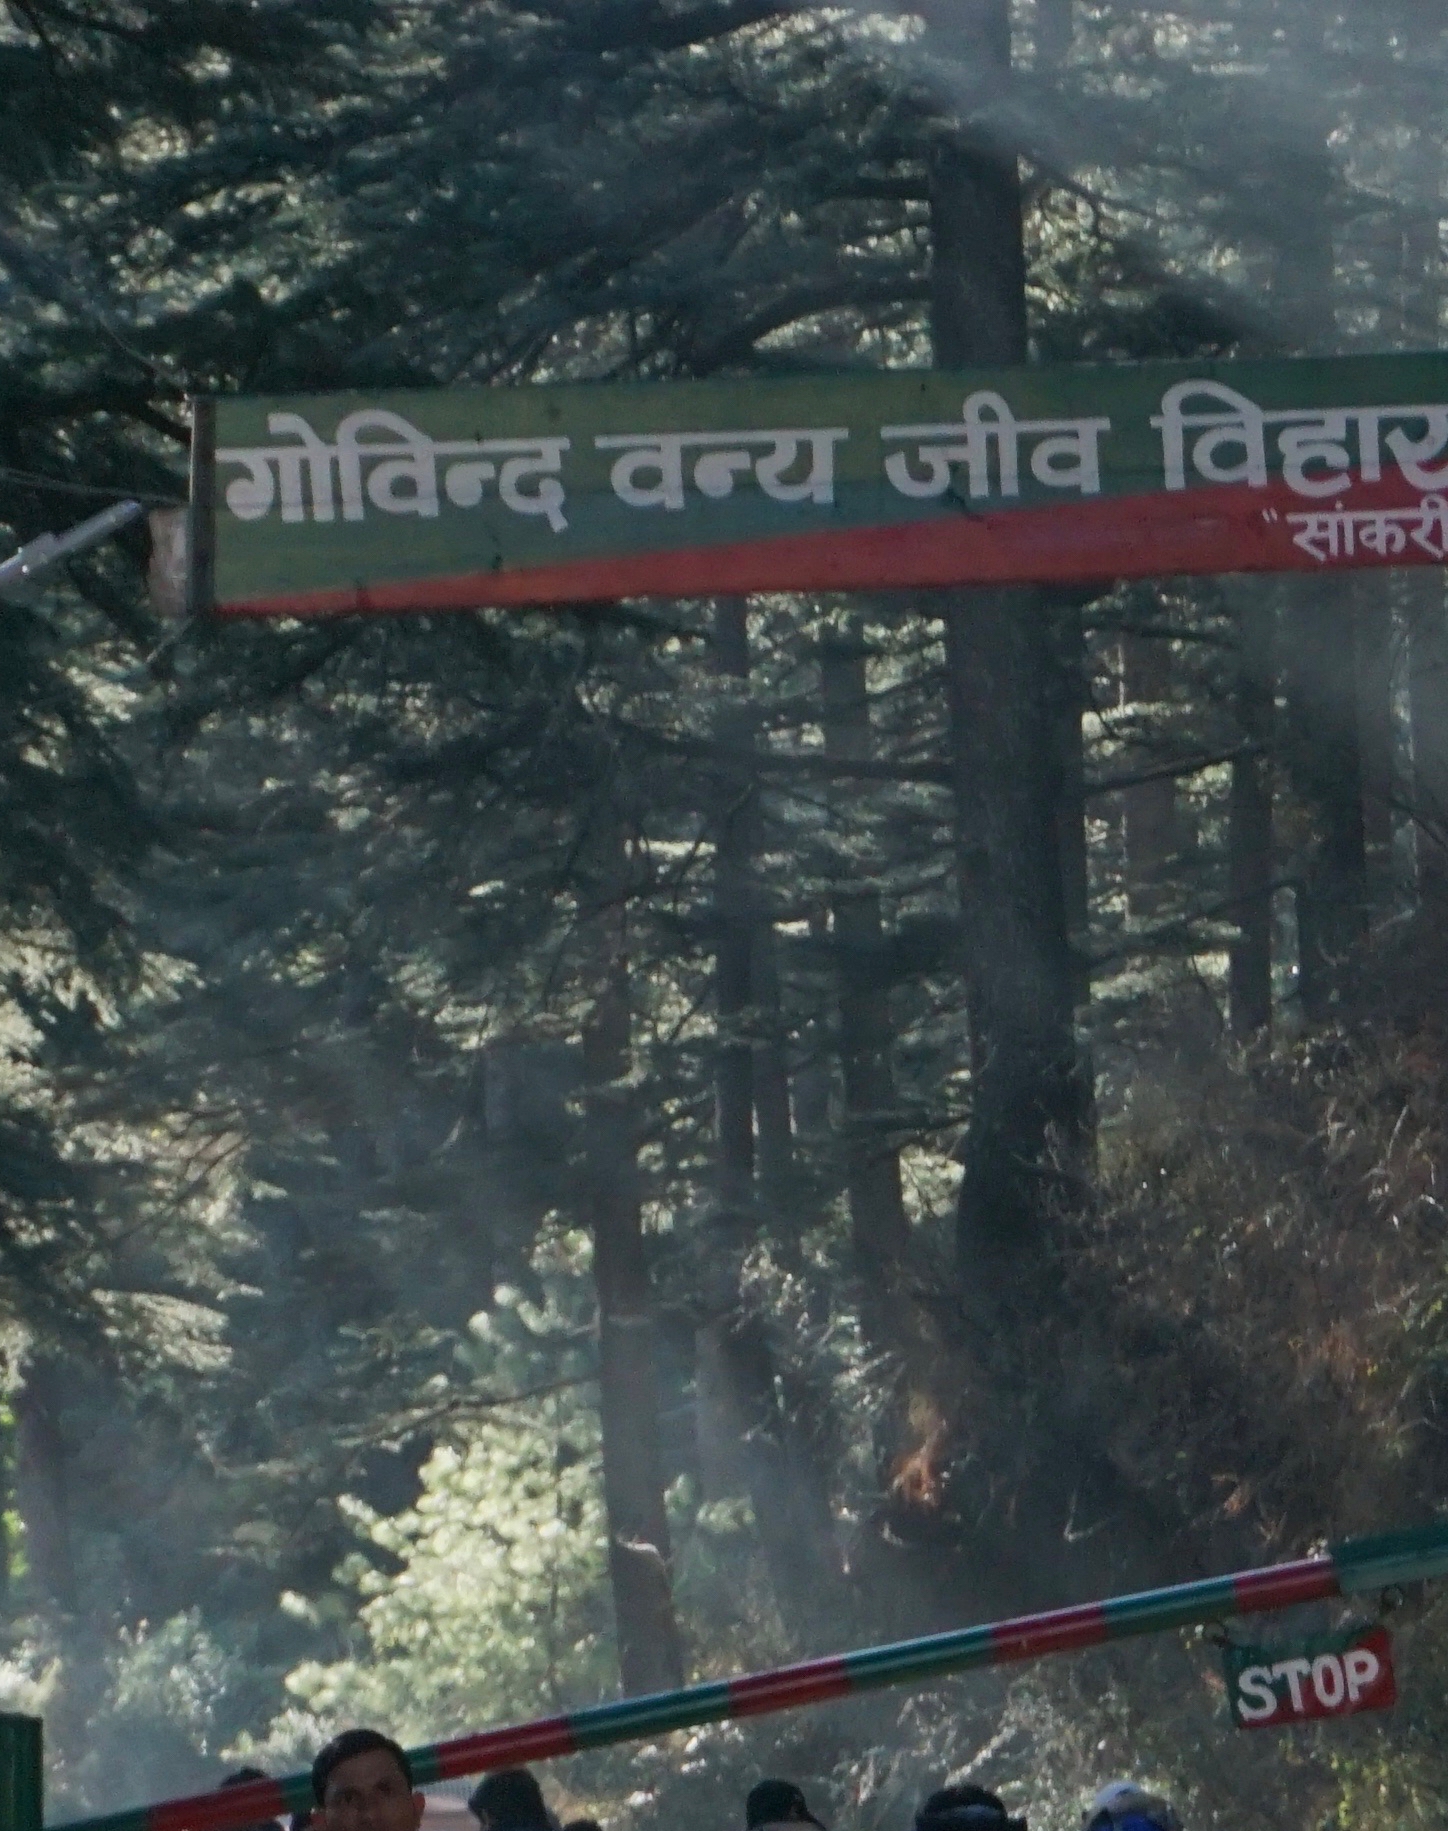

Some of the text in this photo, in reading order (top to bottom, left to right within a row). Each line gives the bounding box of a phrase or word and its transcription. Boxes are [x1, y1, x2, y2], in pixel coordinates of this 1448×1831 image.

[215, 411, 570, 532] गोविन्द
[596, 426, 850, 509] वन्य
[882, 390, 1110, 500] जीव
[1237, 1648, 1380, 1722] STOP
